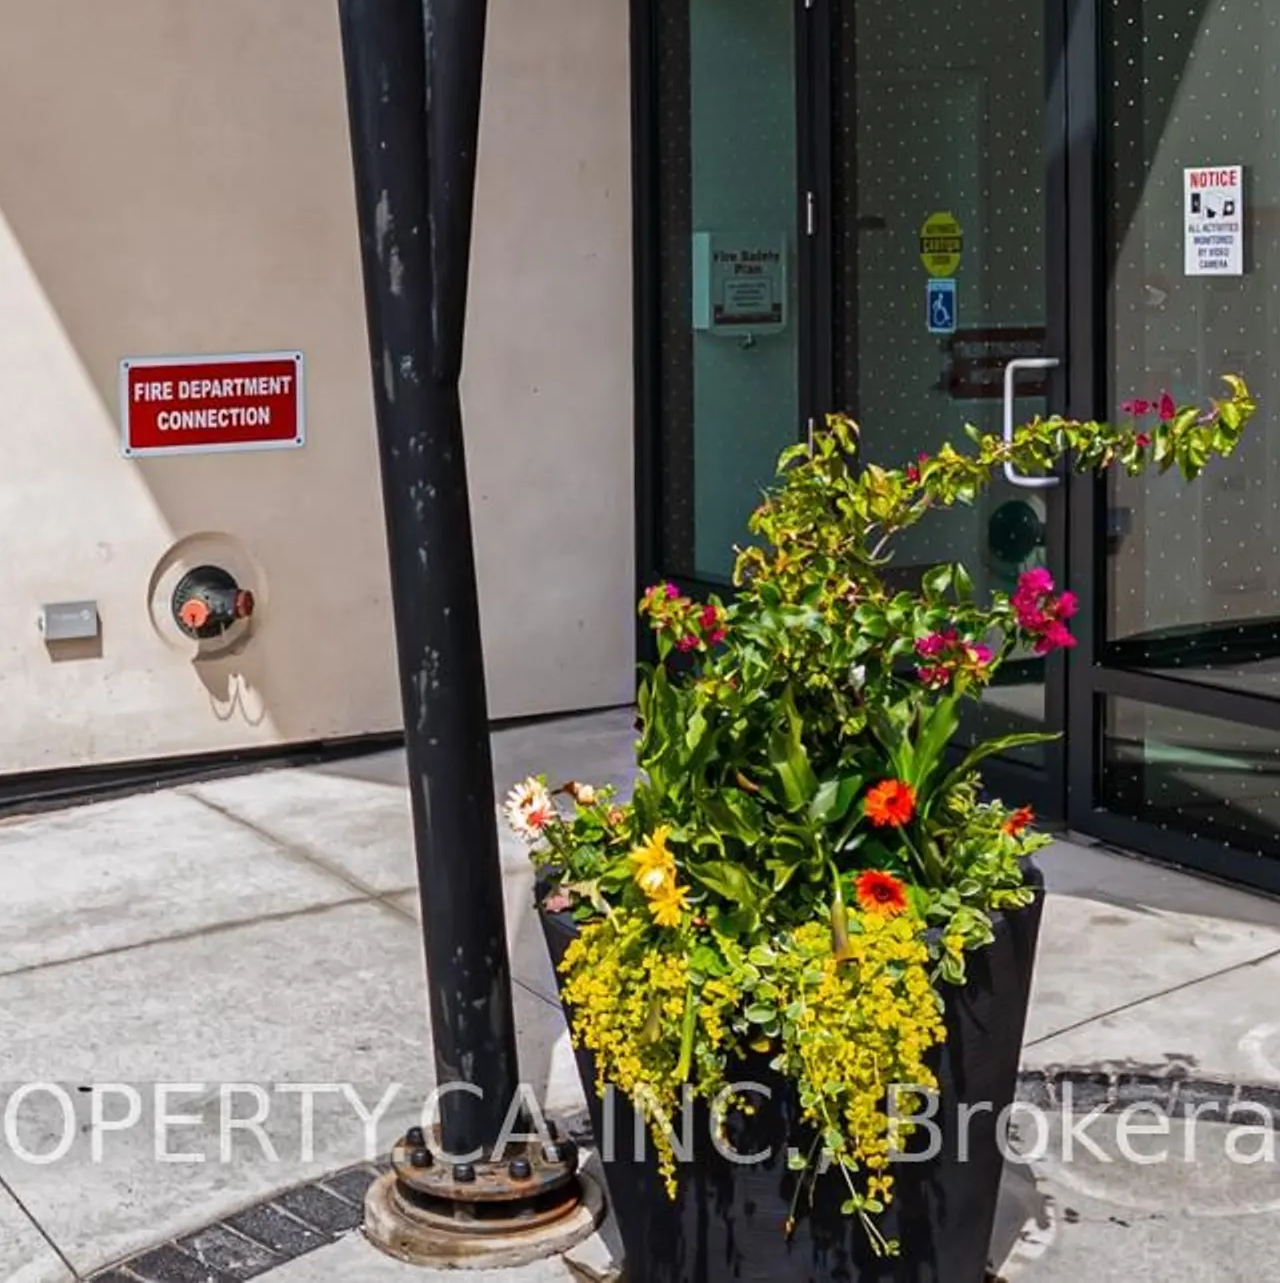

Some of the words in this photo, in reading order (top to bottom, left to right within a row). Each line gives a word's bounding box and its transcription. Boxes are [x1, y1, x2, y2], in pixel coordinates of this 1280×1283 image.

[1190, 170, 1237, 189] NOTICE
[1188, 224, 1201, 234] ALL
[134, 381, 173, 402] FIRE
[178, 375, 292, 400] DEPARTMENT
[157, 406, 270, 431] CONNECTION
